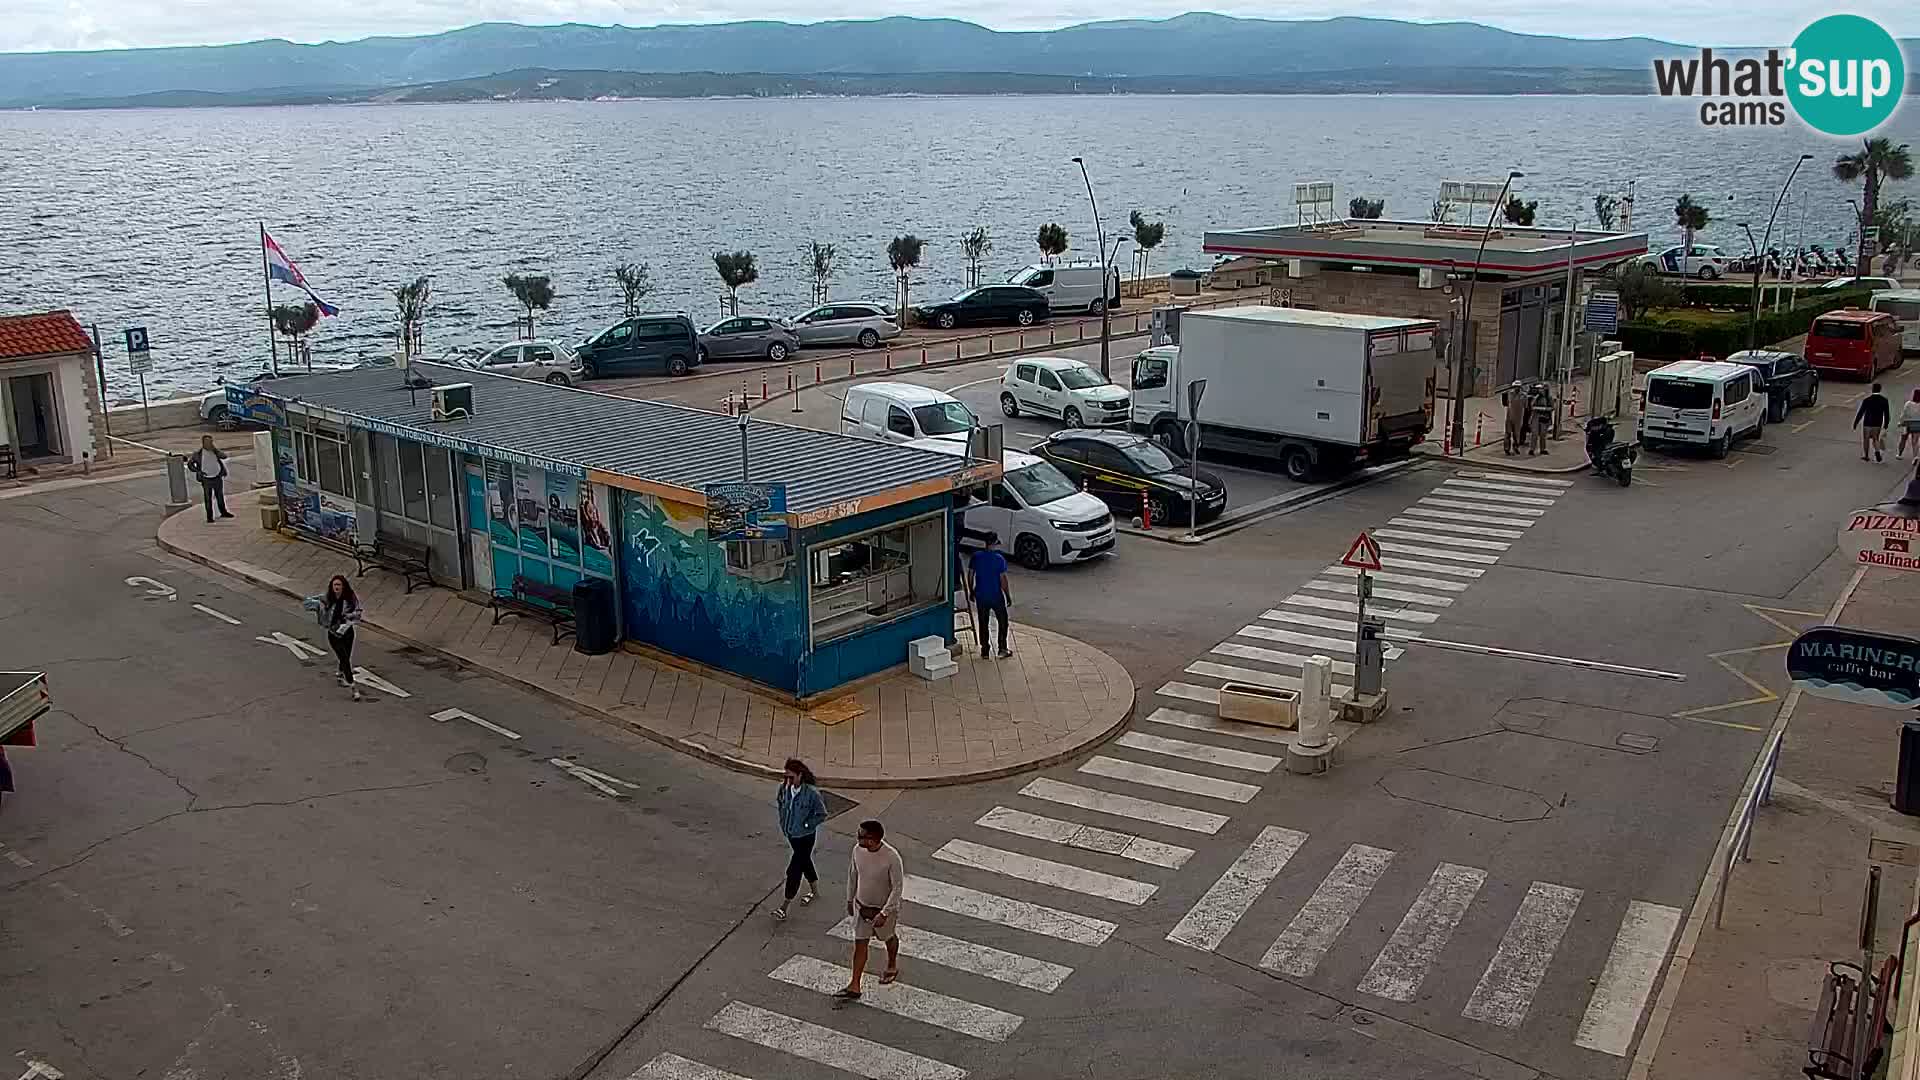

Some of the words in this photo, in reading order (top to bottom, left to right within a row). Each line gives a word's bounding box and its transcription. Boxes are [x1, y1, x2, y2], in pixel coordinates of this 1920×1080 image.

[131, 331, 144, 349] P
[397, 426, 436, 445] AUTOBUSNA
[437, 436, 468, 452] POSTAJA
[478, 445, 494, 458] BUS
[494, 449, 526, 465] STATION
[529, 457, 554, 471] TICKET
[555, 463, 584, 477] OFFICE
[1827, 662, 1865, 675] caffe
[1869, 664, 1897, 680] bar
